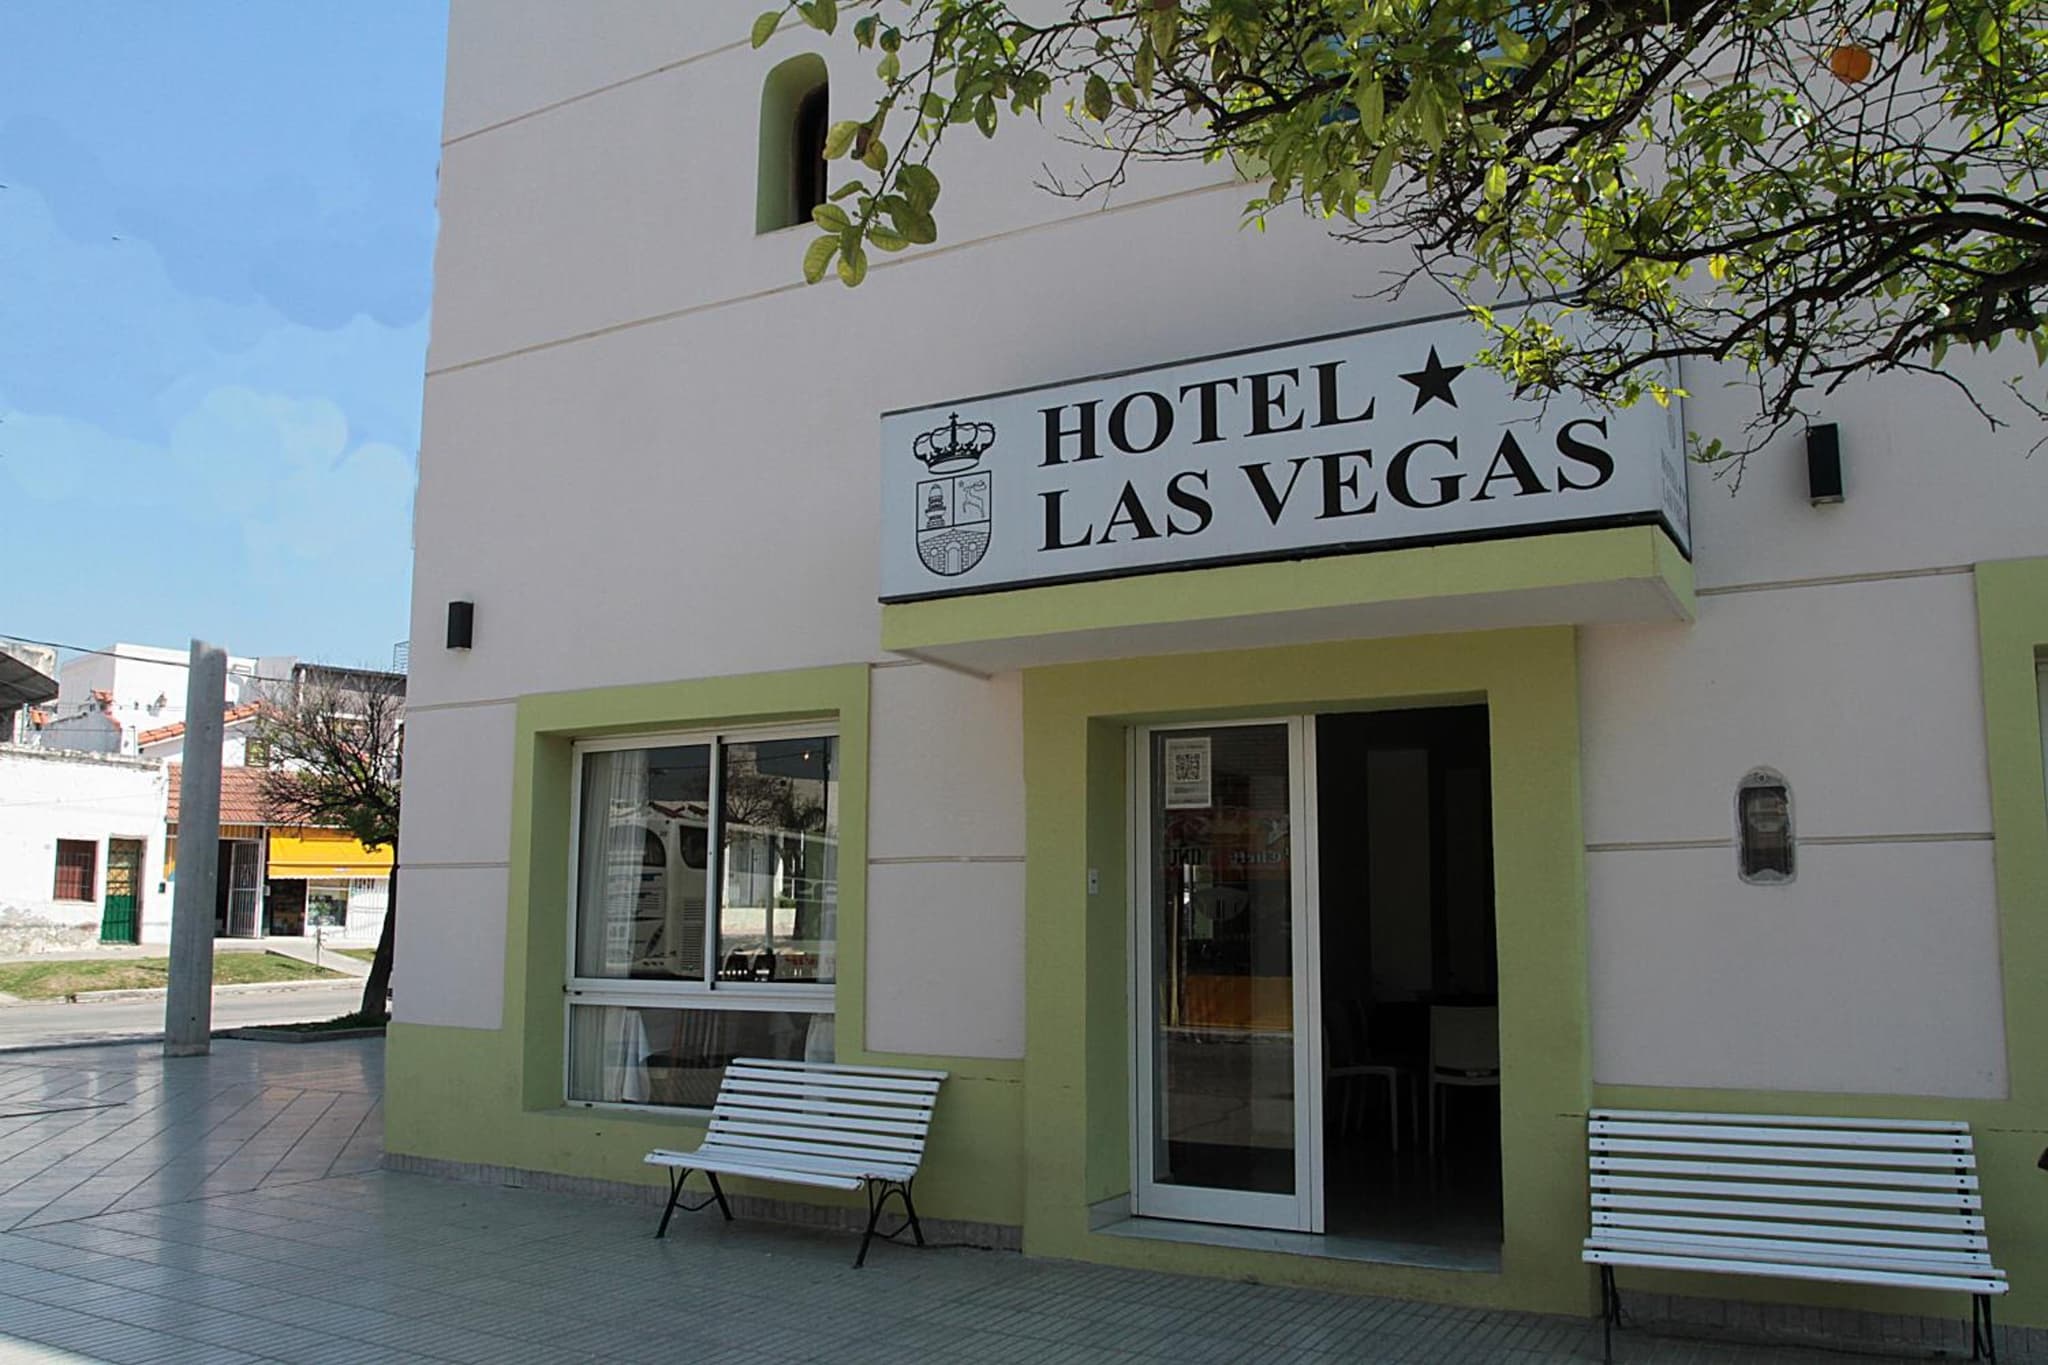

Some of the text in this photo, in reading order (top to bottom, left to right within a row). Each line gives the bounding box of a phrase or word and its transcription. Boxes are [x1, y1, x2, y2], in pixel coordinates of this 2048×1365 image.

[1037, 360, 1376, 468] HOTEL
[1037, 469, 1213, 552] LAS
[1238, 415, 1615, 526] VEGAS
